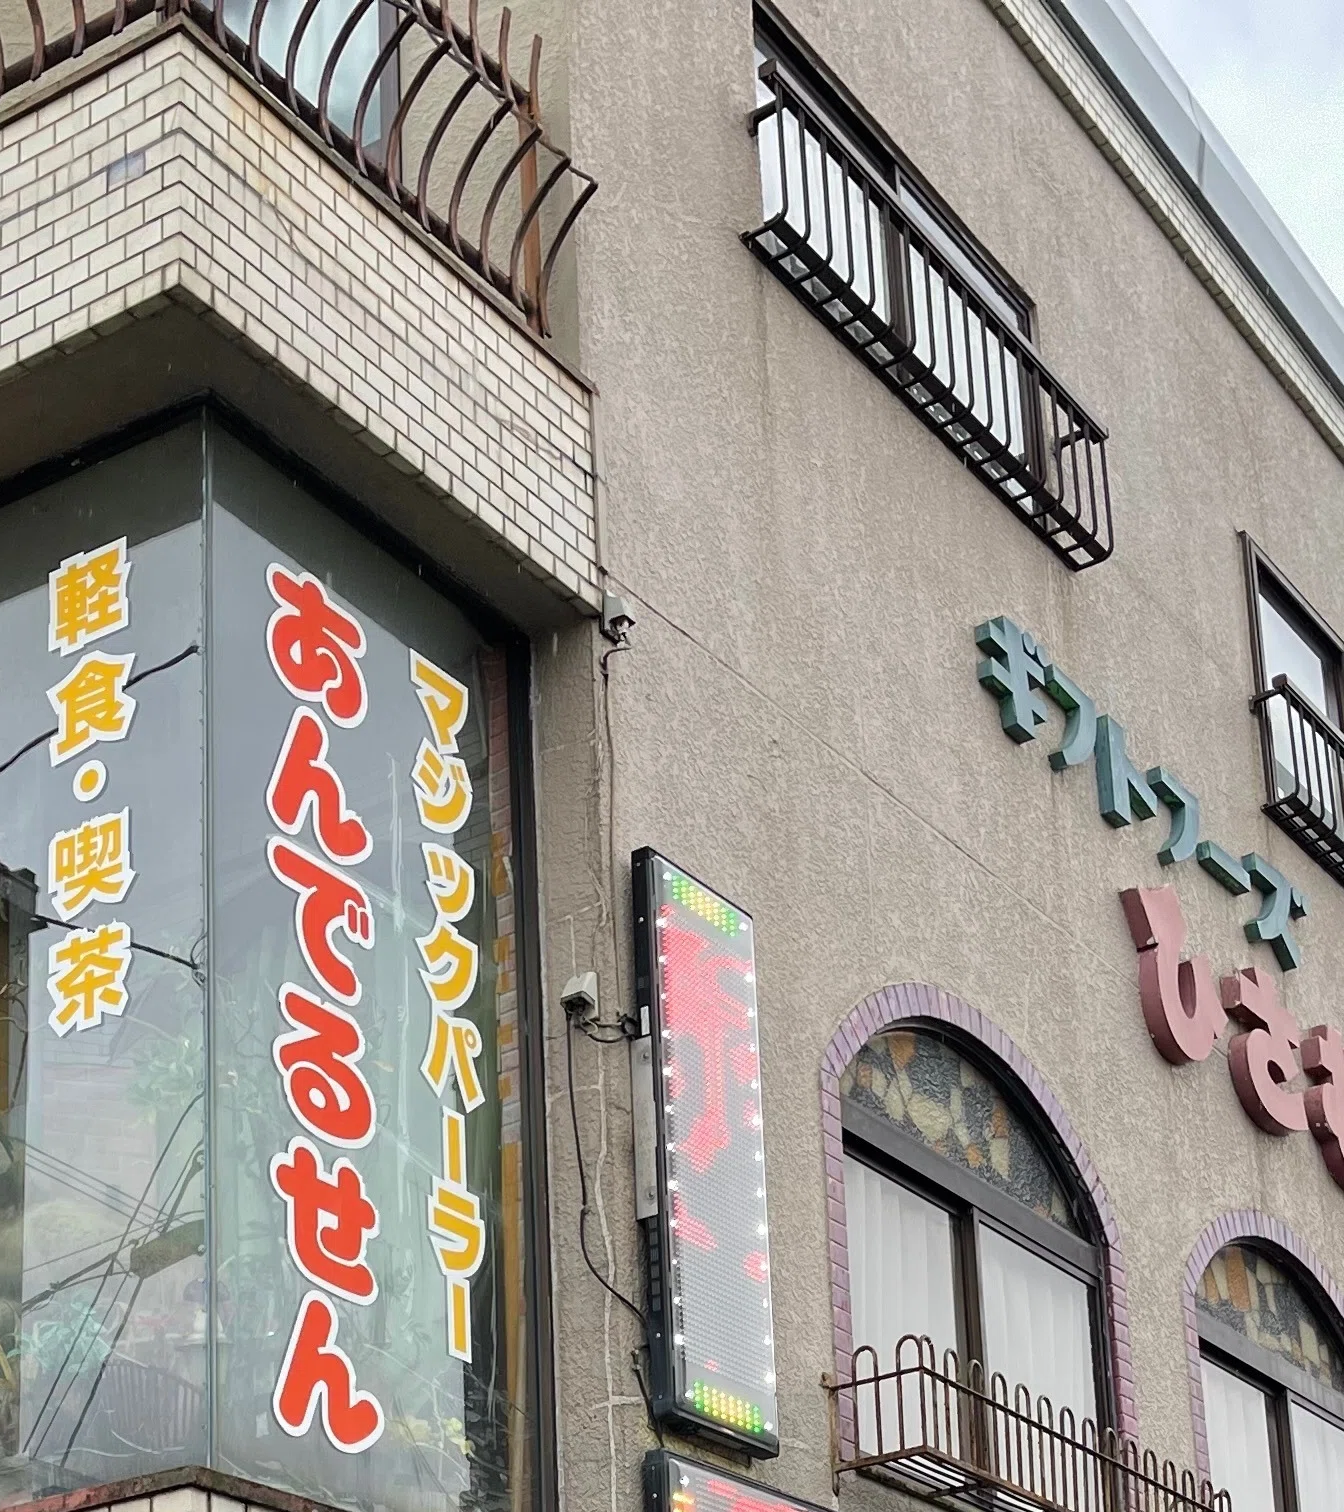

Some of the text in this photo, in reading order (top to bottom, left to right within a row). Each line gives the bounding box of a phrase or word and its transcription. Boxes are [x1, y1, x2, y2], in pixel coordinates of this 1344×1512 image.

[48, 535, 137, 1038] 軽食・喫茶
[266, 560, 385, 1454] あんでるせん
[409, 648, 485, 1365] マジックパーラー
